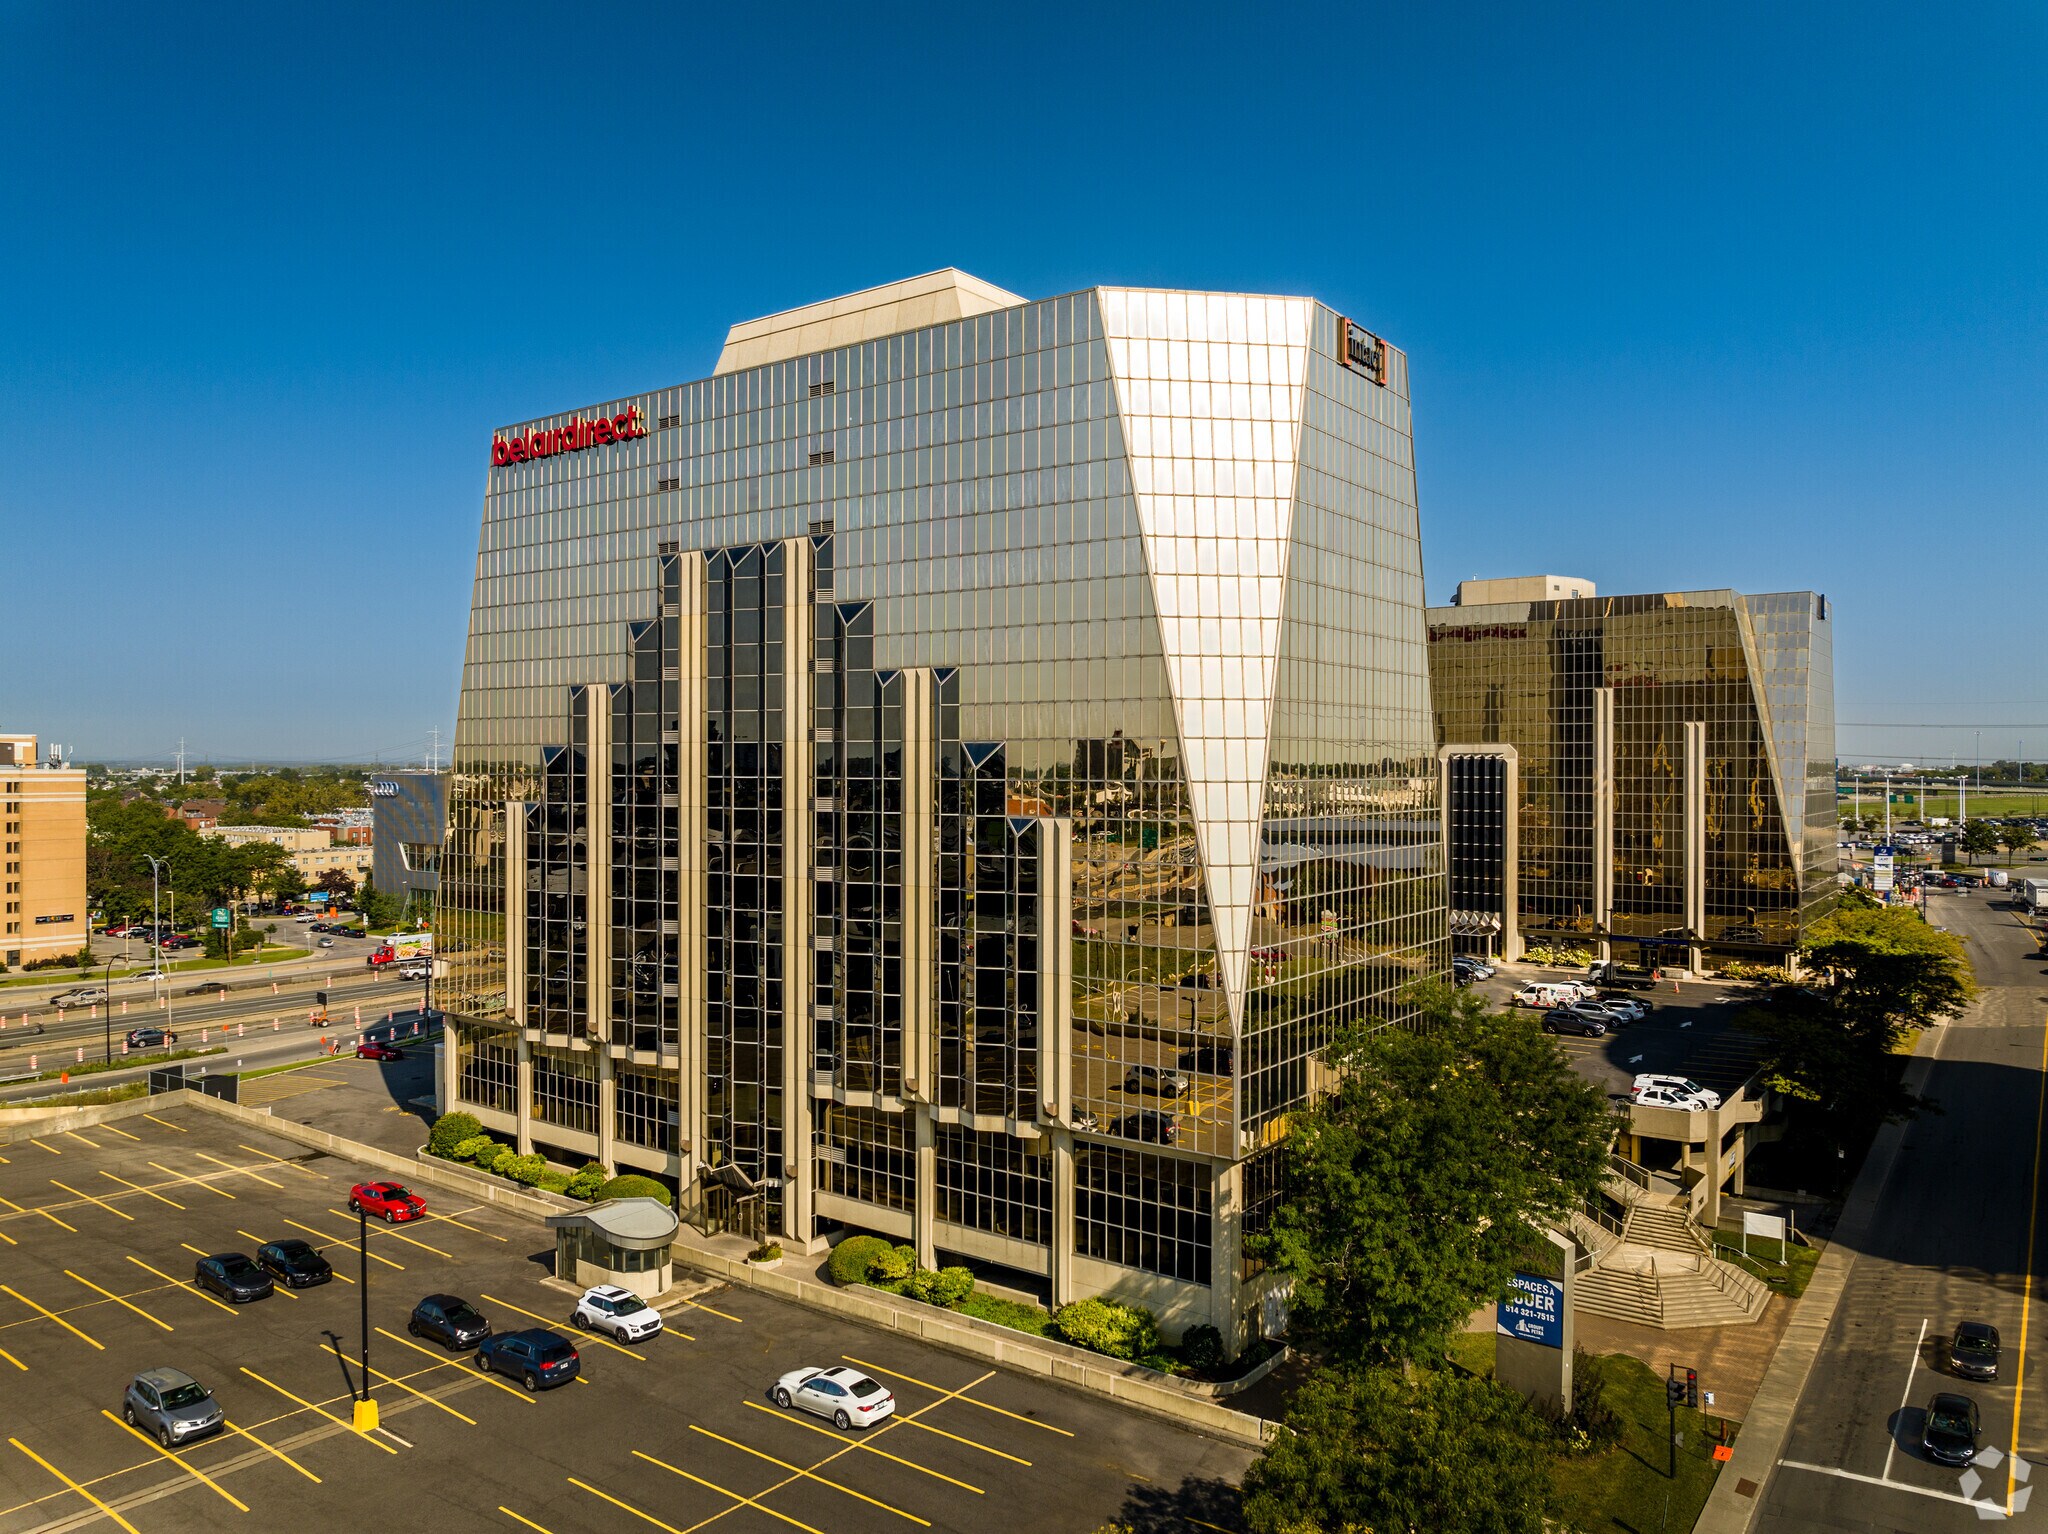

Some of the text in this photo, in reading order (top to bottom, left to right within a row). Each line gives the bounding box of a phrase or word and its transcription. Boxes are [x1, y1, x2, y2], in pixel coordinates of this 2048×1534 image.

[1506, 1277, 1549, 1295] ESPACES
[1511, 1293, 1555, 1312] OUER
[1505, 1304, 1555, 1323] 514 321-7515
